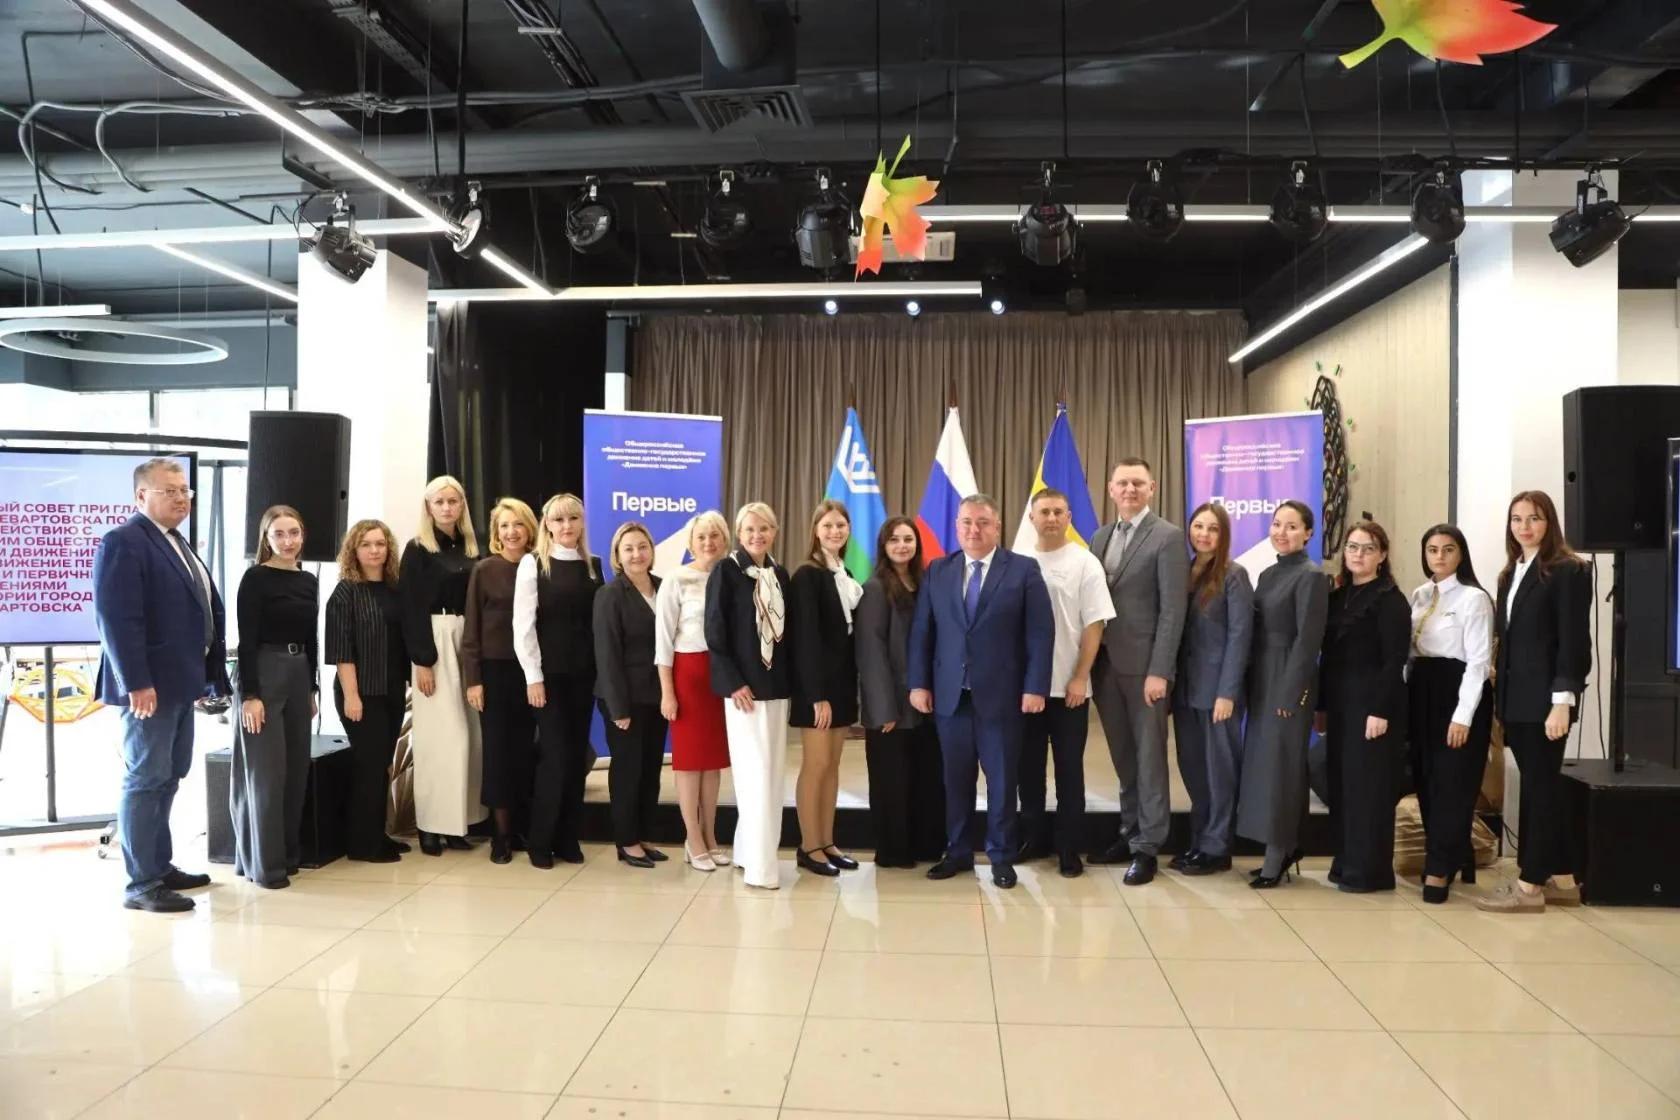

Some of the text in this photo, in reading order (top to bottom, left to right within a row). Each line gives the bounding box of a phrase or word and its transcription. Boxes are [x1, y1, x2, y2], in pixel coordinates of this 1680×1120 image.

[24, 503, 76, 513] СОВЕТ
[79, 504, 109, 514] ПРИ
[612, 491, 697, 517] Первые
[106, 515, 128, 525] ПО
[82, 526, 92, 536] С
[0, 559, 72, 568] ИЖЕНИЕ
[3, 570, 93, 579] И ПЕРВИЧН
[0, 581, 67, 590] ЕНИЯМИ
[41, 592, 93, 602] ГОРОД
[0, 603, 82, 612] АРТОВСКА
